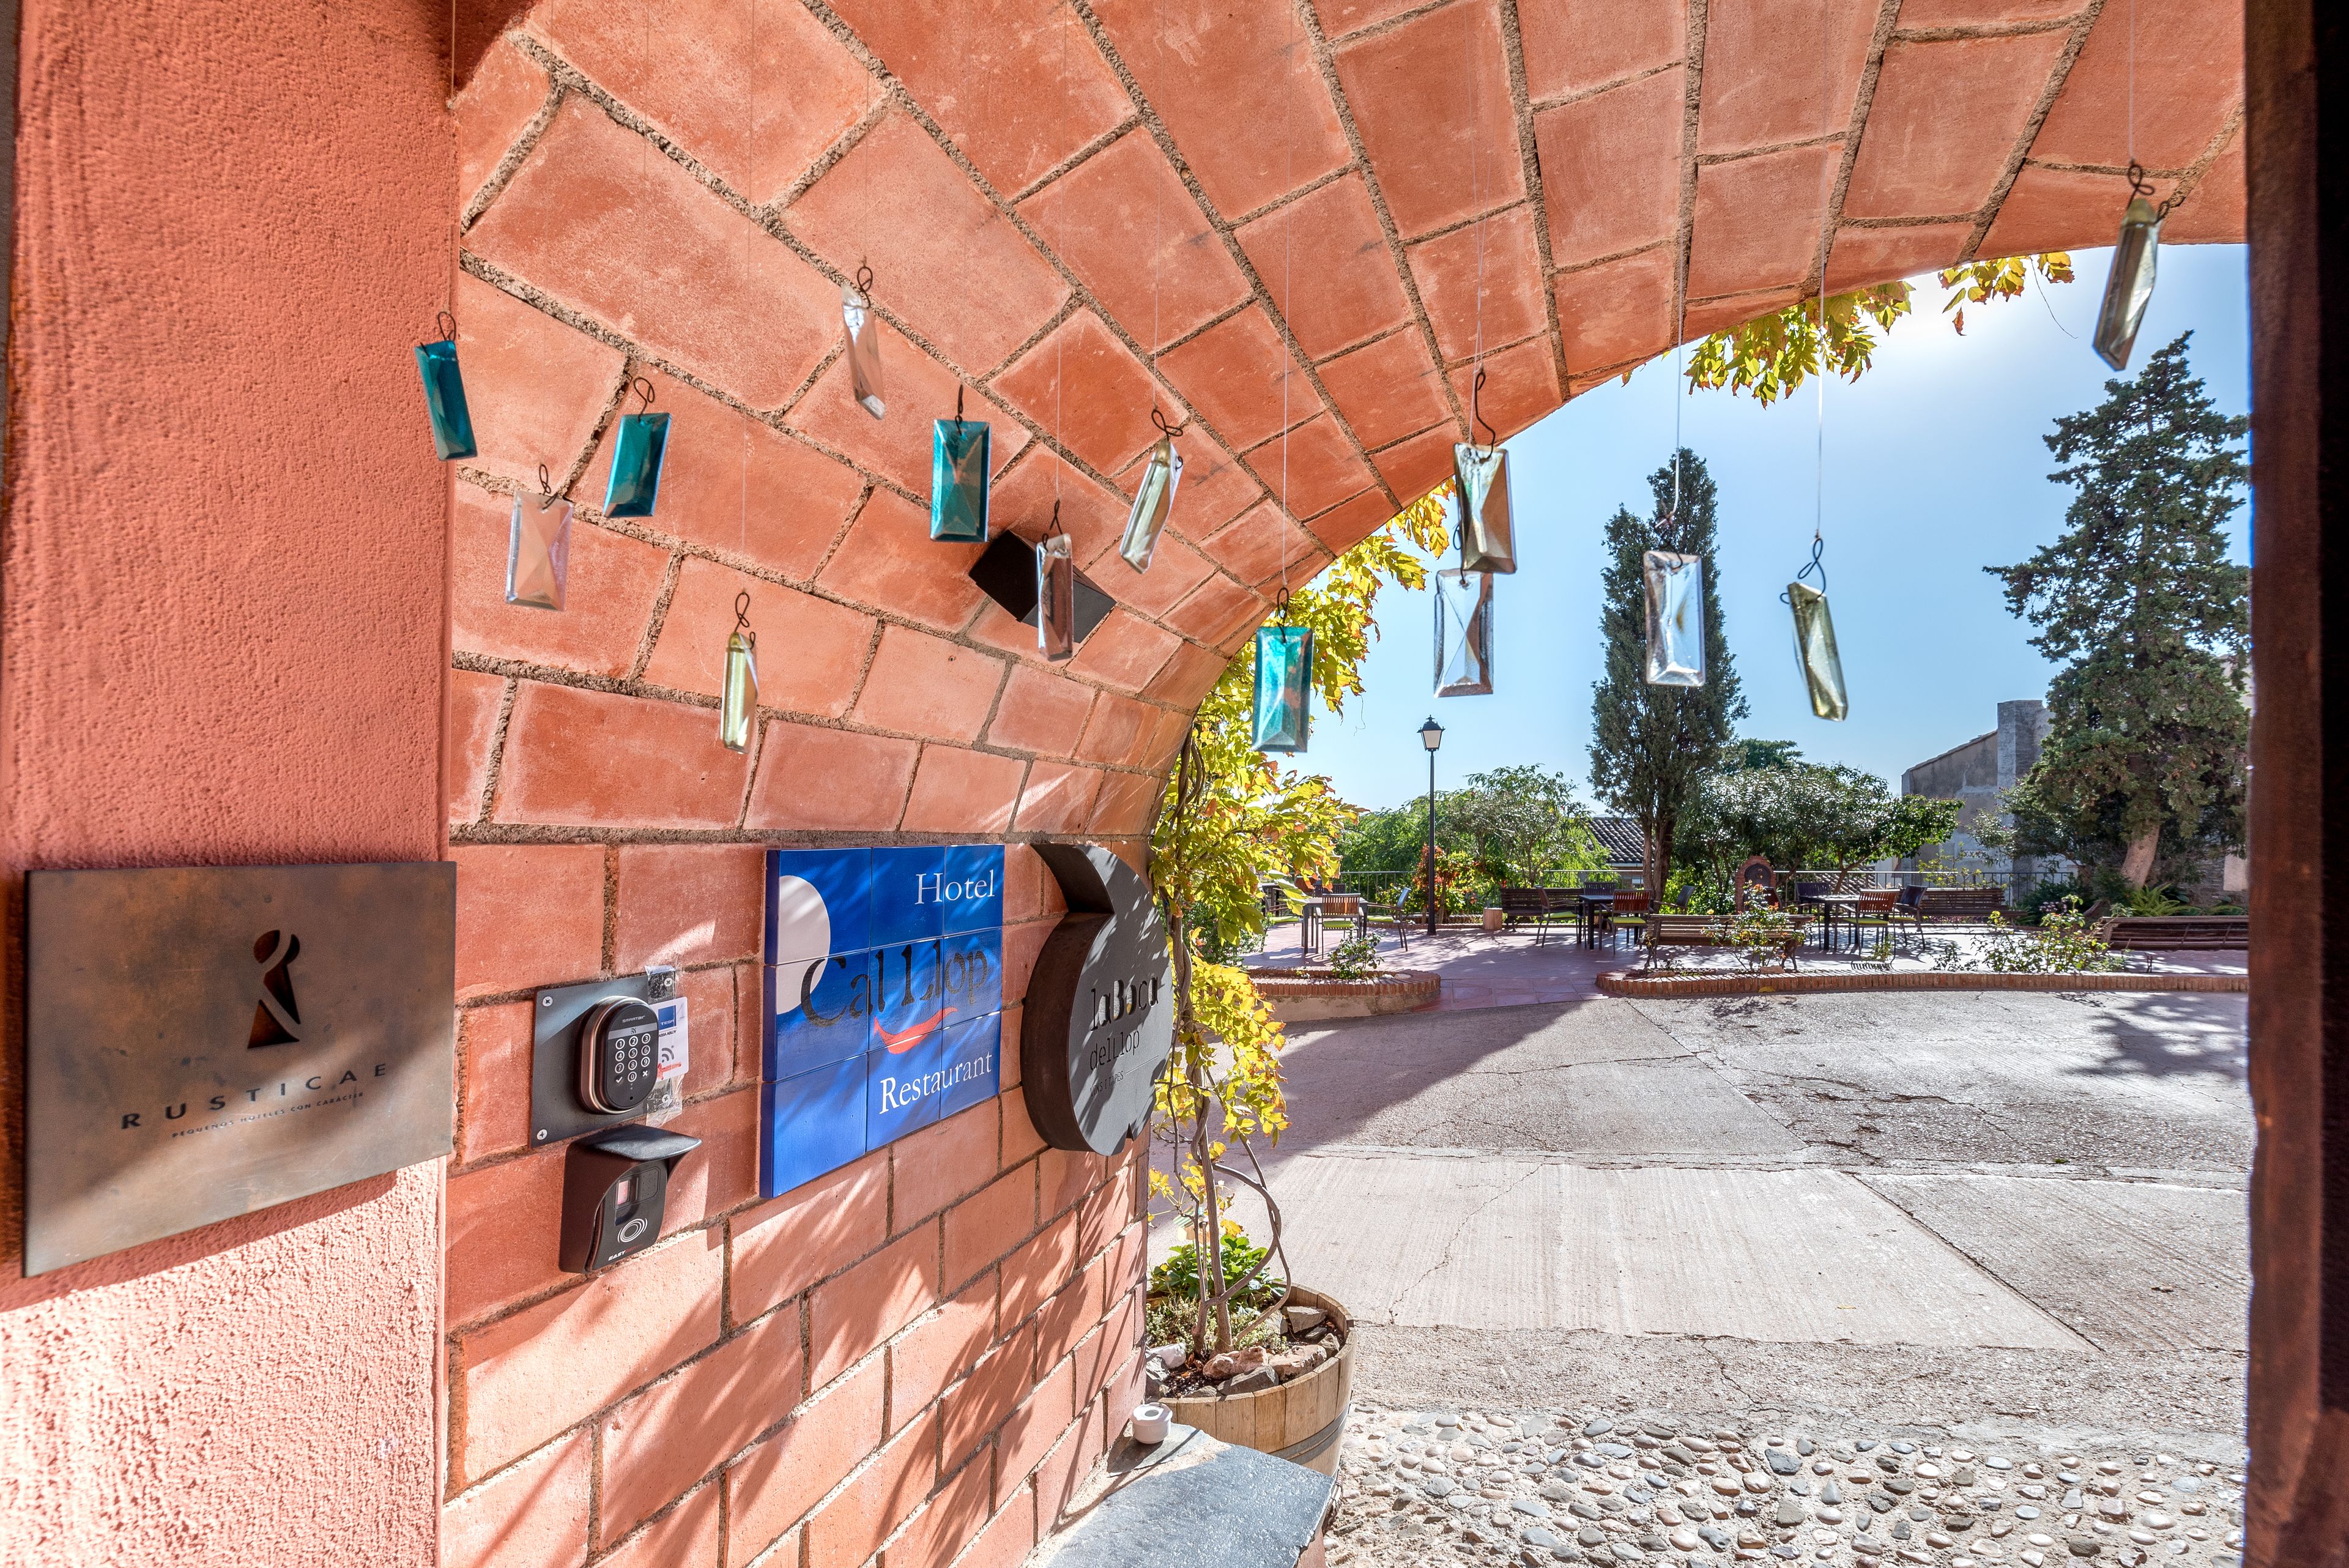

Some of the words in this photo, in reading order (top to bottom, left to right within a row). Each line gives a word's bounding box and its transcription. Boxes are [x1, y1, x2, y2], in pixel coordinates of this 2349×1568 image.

[915, 869, 995, 905] Hotel
[800, 949, 886, 1028] Cal
[900, 939, 989, 1006] Llop
[121, 1063, 386, 1129] RUSTICAE
[879, 1050, 993, 1115] Restaurant
[1108, 1071, 1124, 1087] TAPES
[291, 1103, 311, 1112] CON
